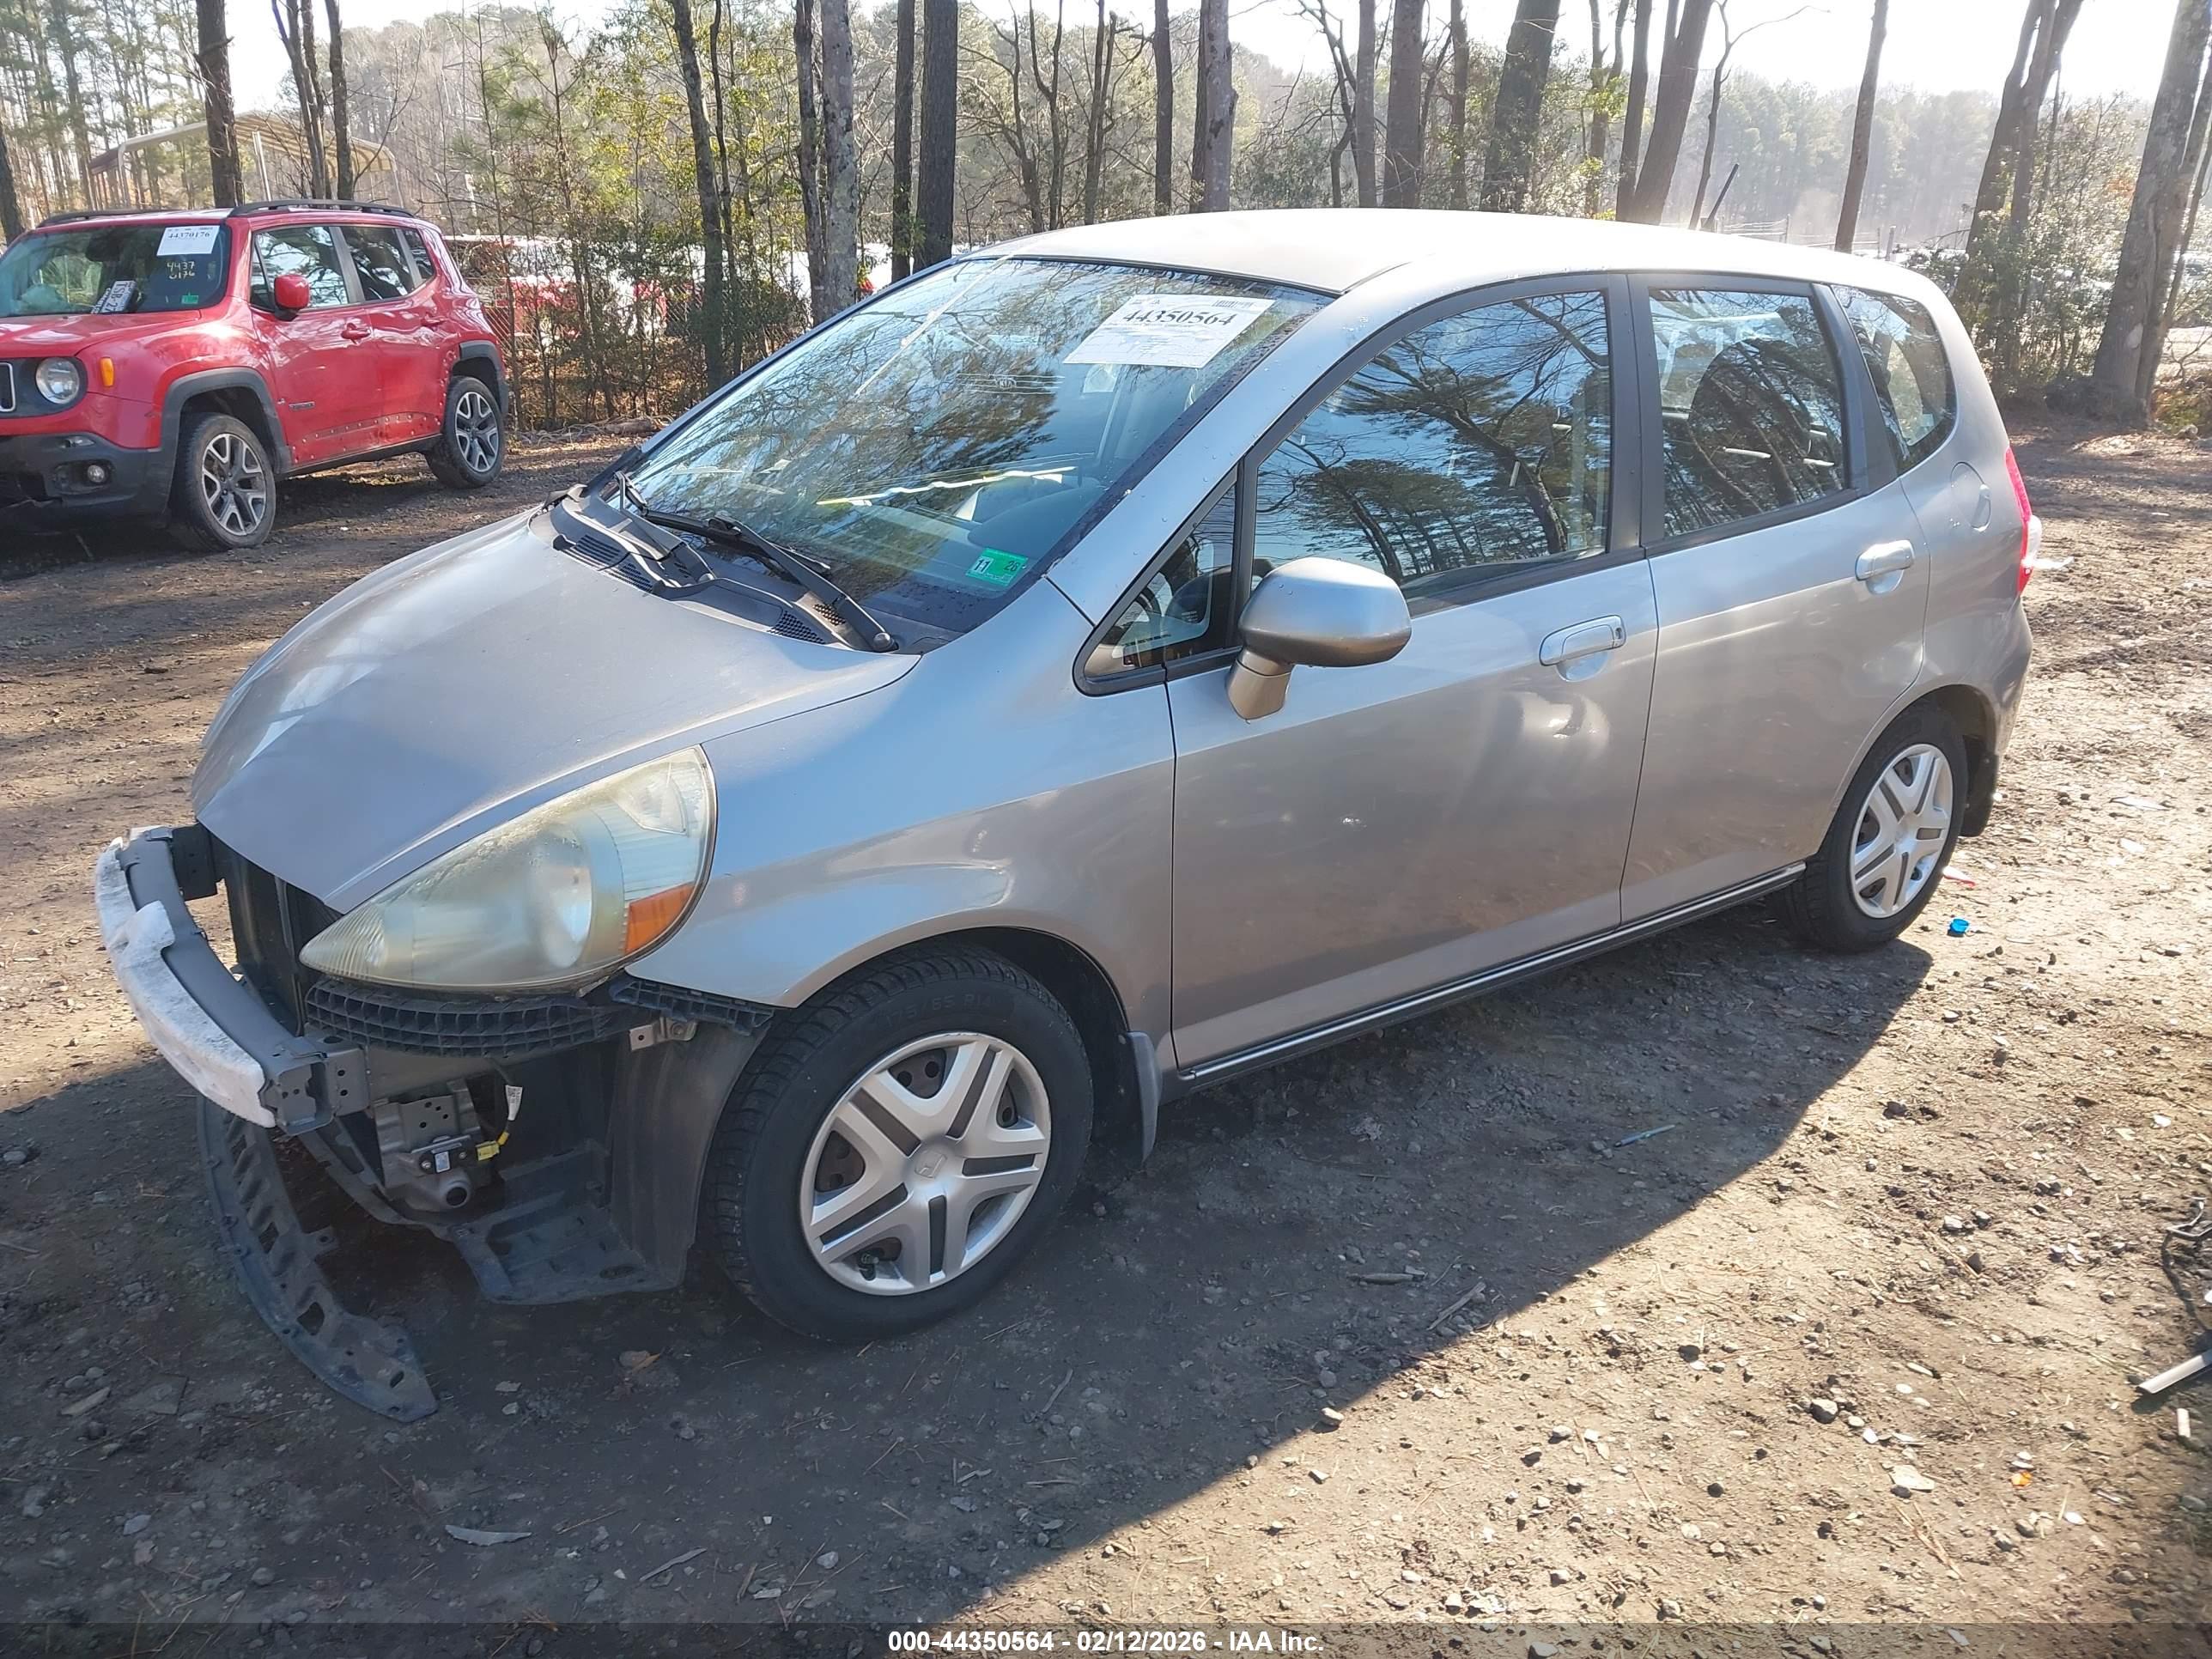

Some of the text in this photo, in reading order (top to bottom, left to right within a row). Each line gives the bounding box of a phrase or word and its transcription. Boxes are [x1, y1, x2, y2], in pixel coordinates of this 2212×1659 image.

[167, 230, 210, 239] 44370176
[167, 261, 195, 272] 4437
[1122, 309, 1237, 326] 44350564
[974, 559, 991, 573] 11
